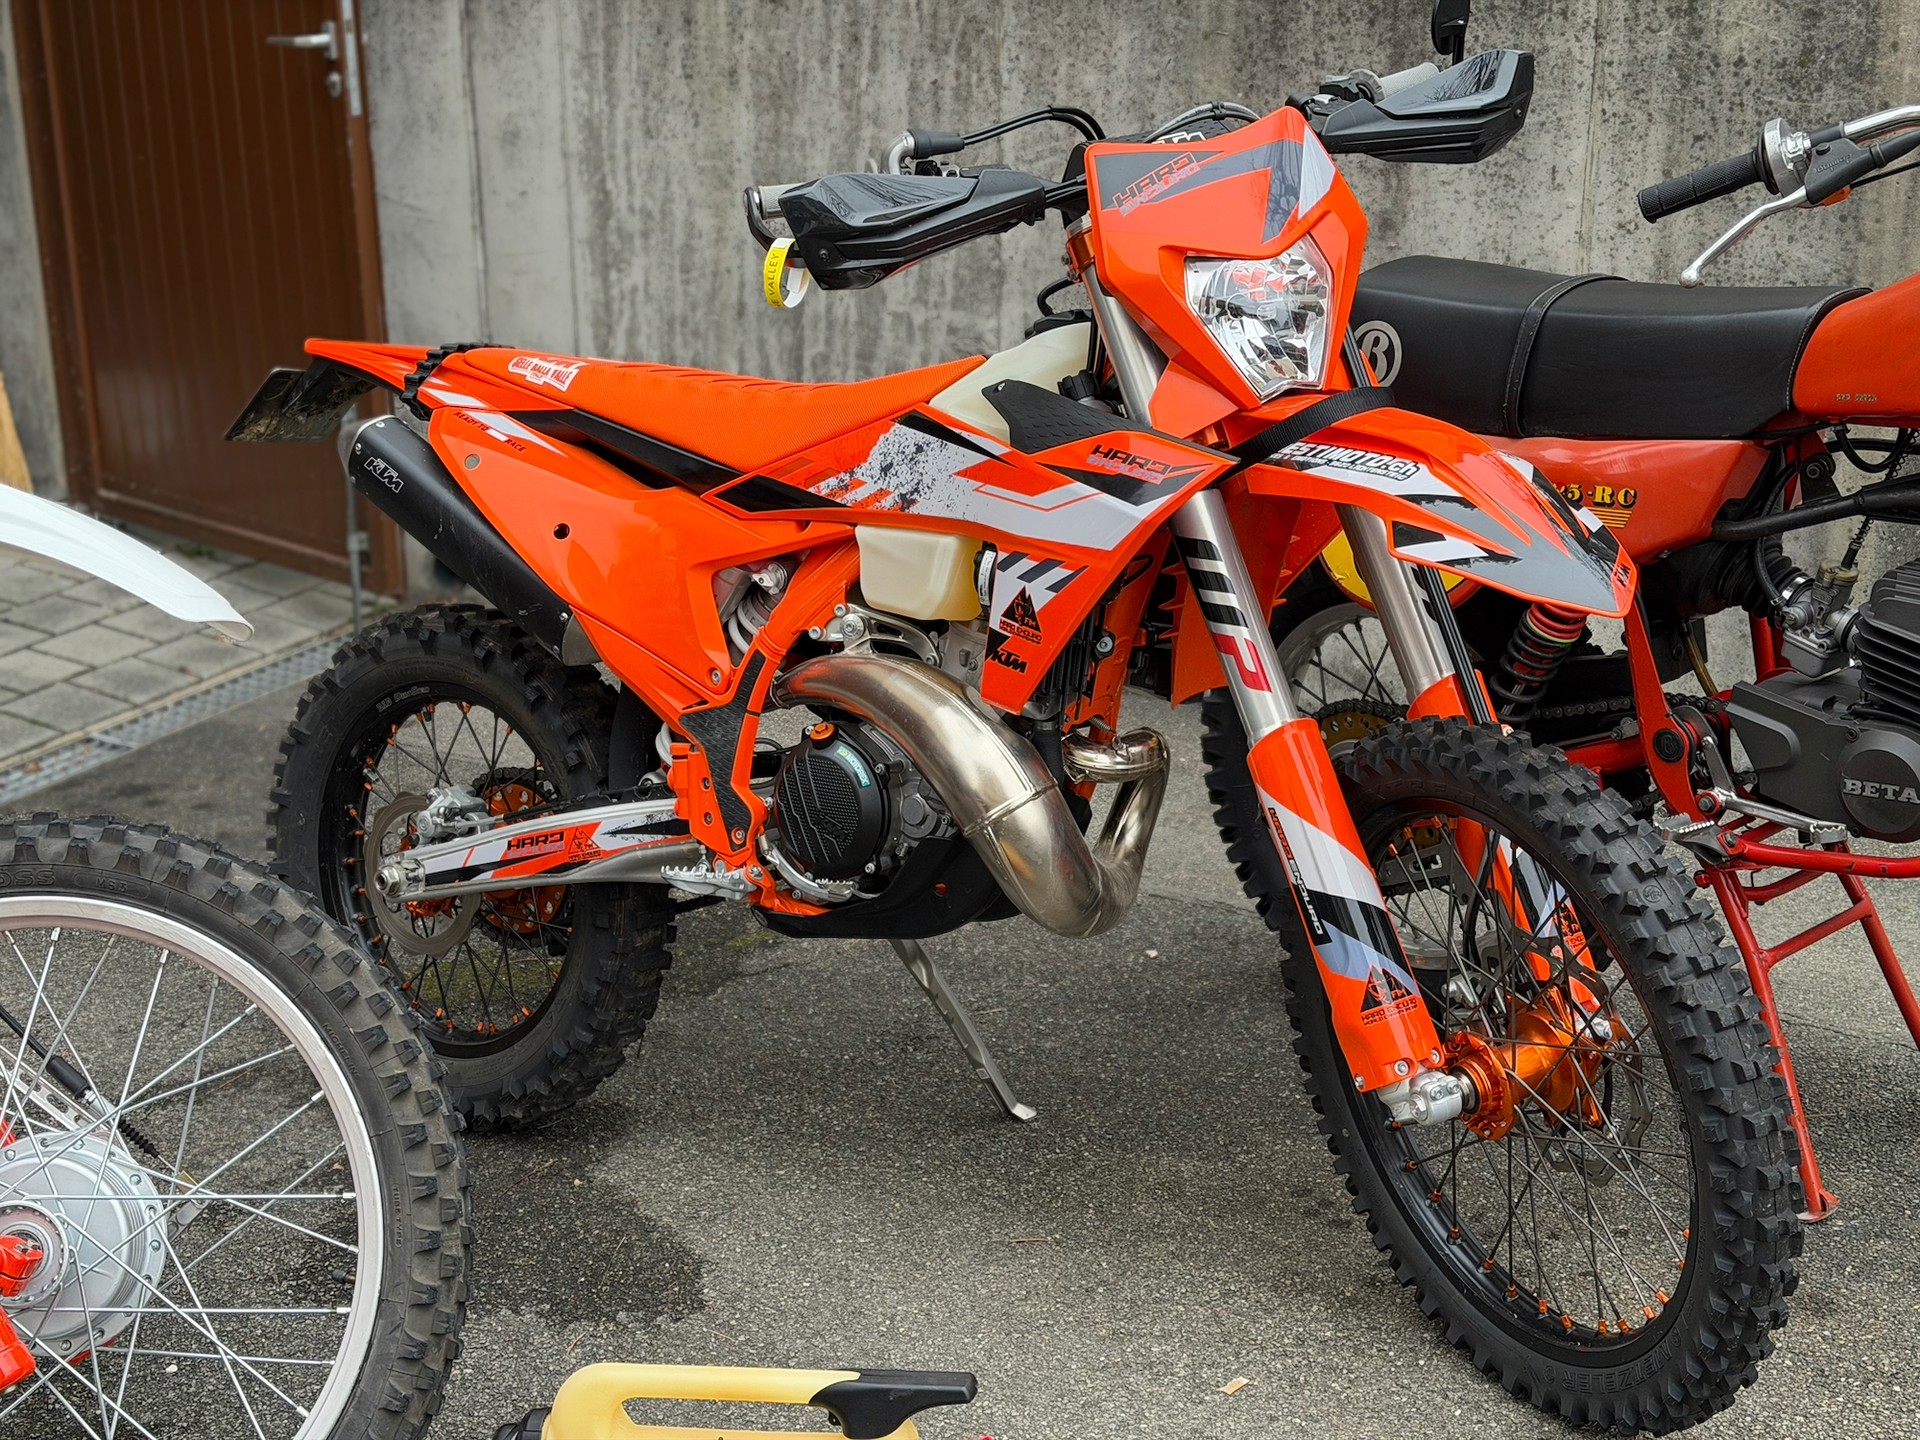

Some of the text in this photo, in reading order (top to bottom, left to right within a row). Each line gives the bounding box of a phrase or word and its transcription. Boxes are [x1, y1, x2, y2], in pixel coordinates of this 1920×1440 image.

[1112, 151, 1198, 208] HARD
[767, 253, 780, 296] VALLEY
[453, 411, 527, 453] READY TO RACE
[363, 456, 404, 493] KTM
[1090, 444, 1171, 476] HARD
[1612, 563, 1631, 588] KTM
[989, 648, 1028, 674] KTM
[1843, 779, 1920, 804] BETA
[507, 831, 564, 850] HARD
[1289, 859, 1323, 935] ENDURO
[322, 1022, 360, 1077] MICHELIN
[1562, 1340, 1673, 1395] METZELER
